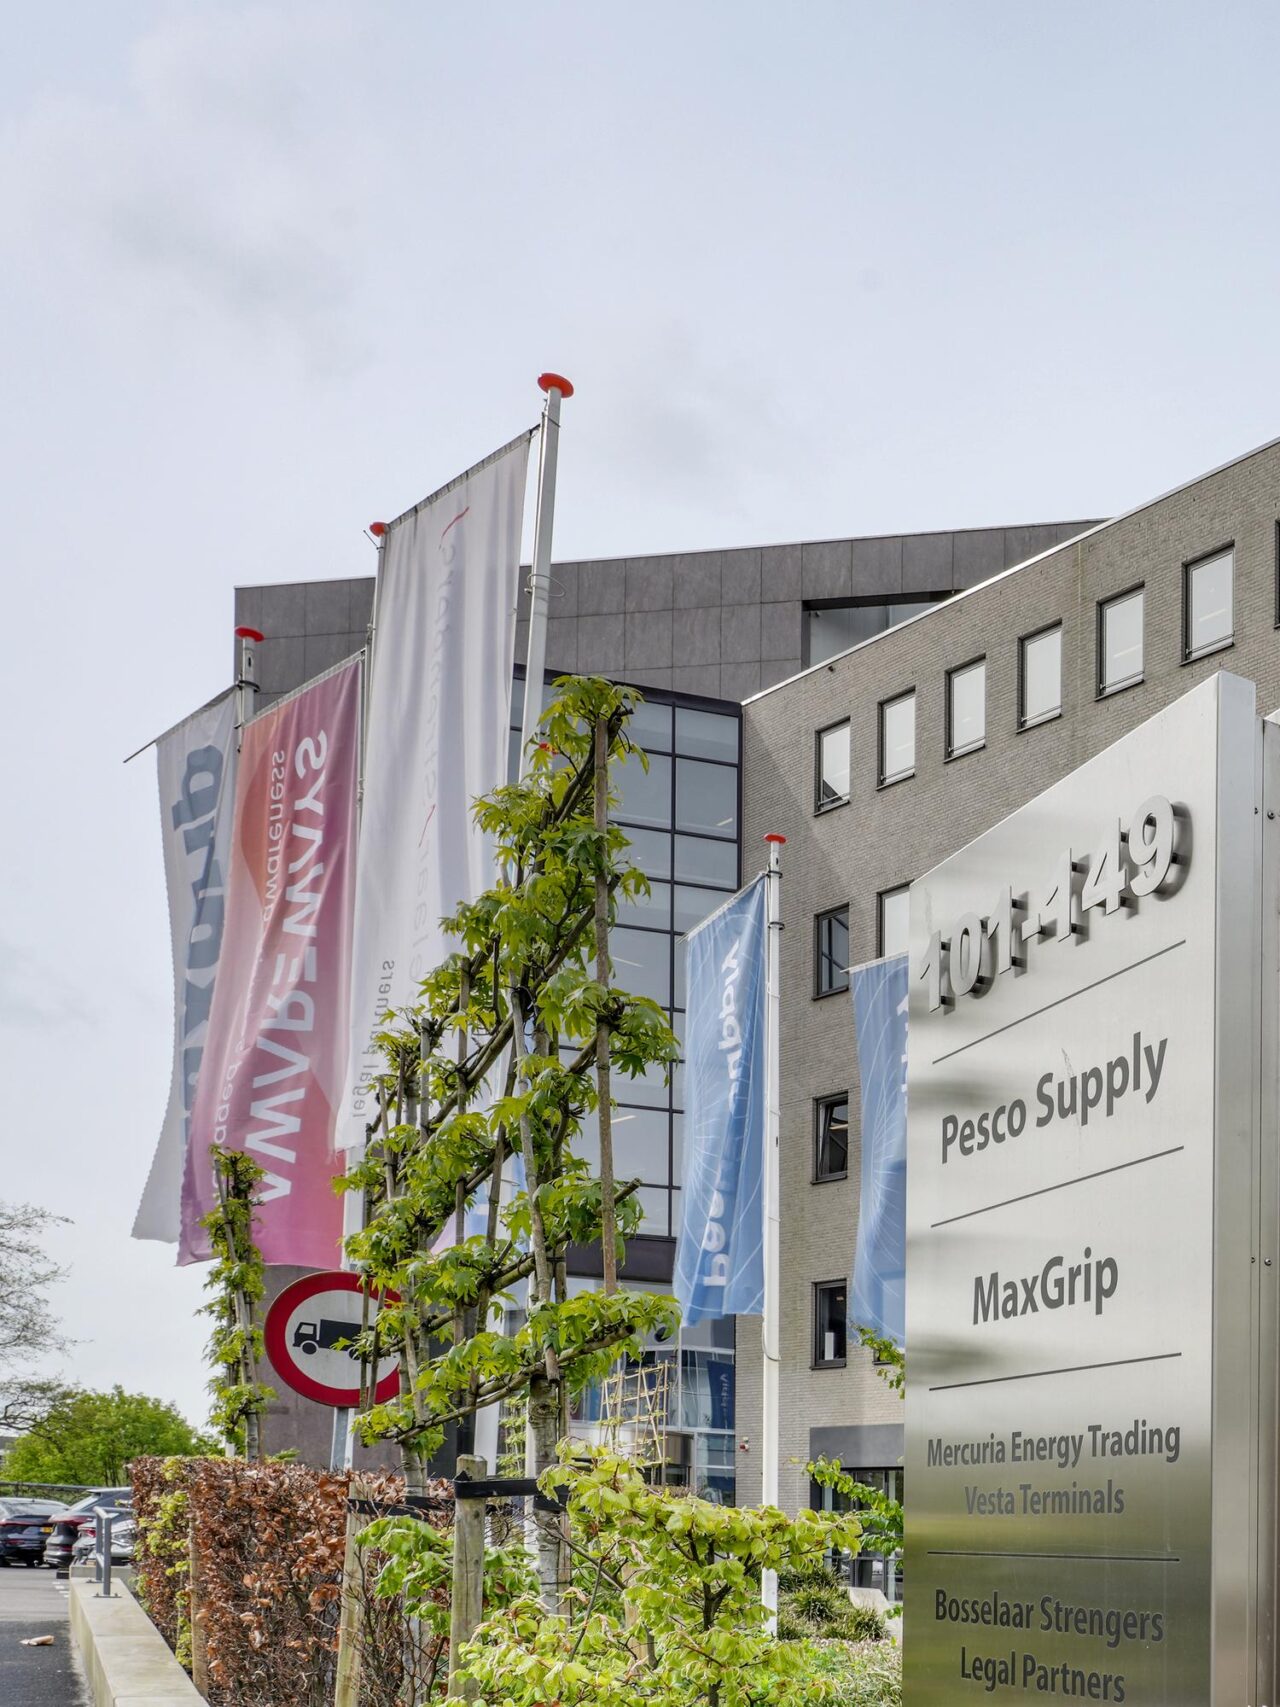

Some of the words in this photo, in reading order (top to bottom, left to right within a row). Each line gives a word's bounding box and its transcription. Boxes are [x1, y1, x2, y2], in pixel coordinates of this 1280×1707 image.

[920, 794, 1177, 1012] 101-149
[942, 1099, 1027, 1164] Pesco
[1036, 1031, 1169, 1127] Supply
[972, 1247, 1120, 1326] MaxGrip
[926, 1431, 1006, 1468] Mercuria
[1011, 1429, 1084, 1468] Energy
[1087, 1419, 1181, 1463] Trading
[964, 1484, 1015, 1516] Vesta
[1019, 1479, 1125, 1516] Terminals
[934, 1588, 1034, 1630] Bosselaar
[1039, 1594, 1164, 1649] Strengers
[960, 1645, 1016, 1694] Legal
[1021, 1653, 1126, 1703] Partners
